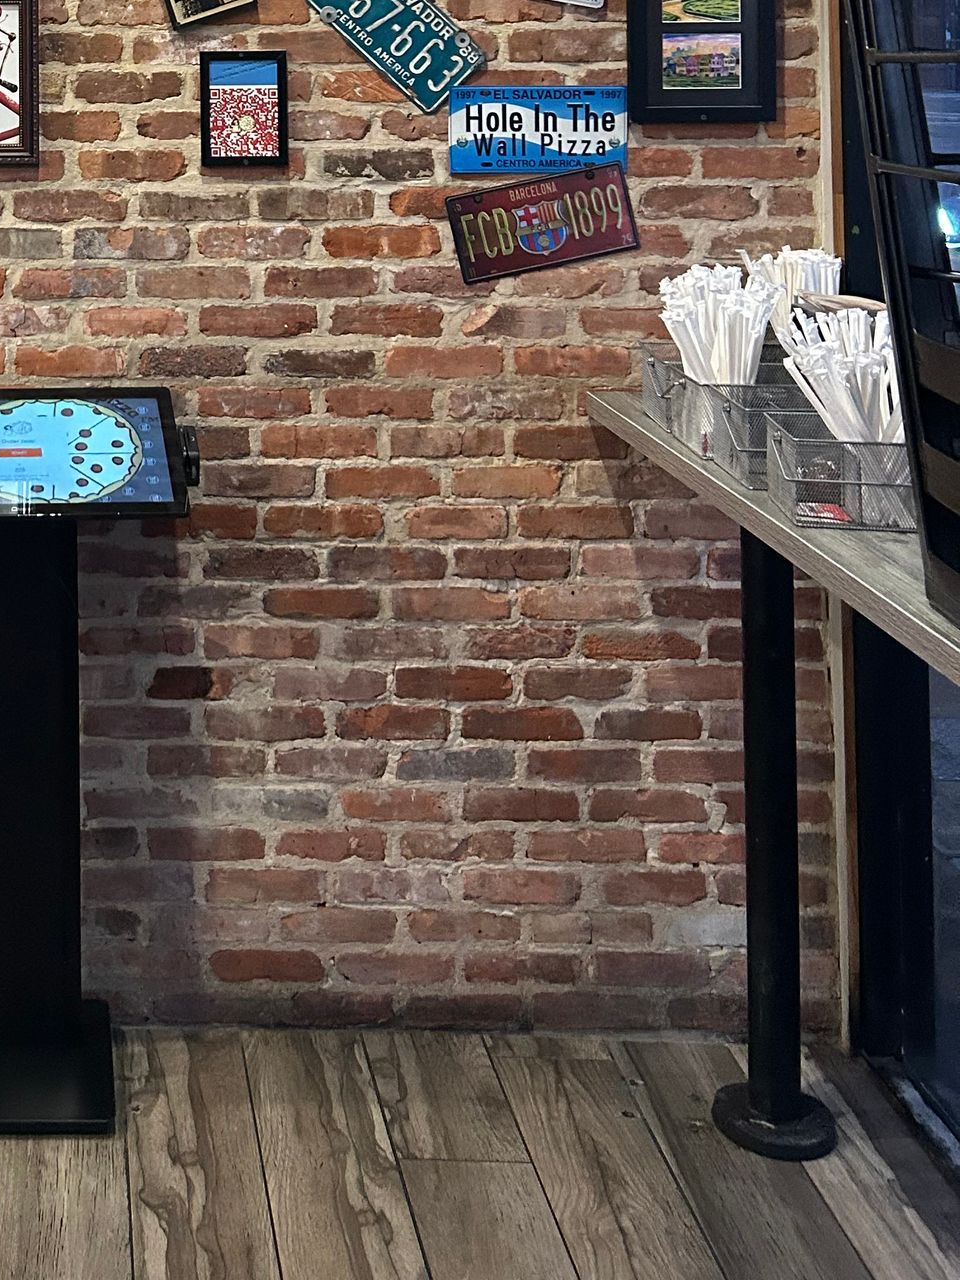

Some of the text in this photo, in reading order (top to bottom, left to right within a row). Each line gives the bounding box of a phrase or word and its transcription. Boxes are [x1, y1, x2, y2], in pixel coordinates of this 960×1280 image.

[373, 46, 417, 88] AMERICA
[455, 89, 623, 101] 1997 EL SALVADOR 1997
[465, 102, 616, 133] Hole In The
[473, 133, 607, 157] Wall Pizza
[495, 159, 583, 169] CENTRO AMERICA
[508, 181, 558, 202] BARCELONA
[460, 182, 623, 263] FCB 1899
